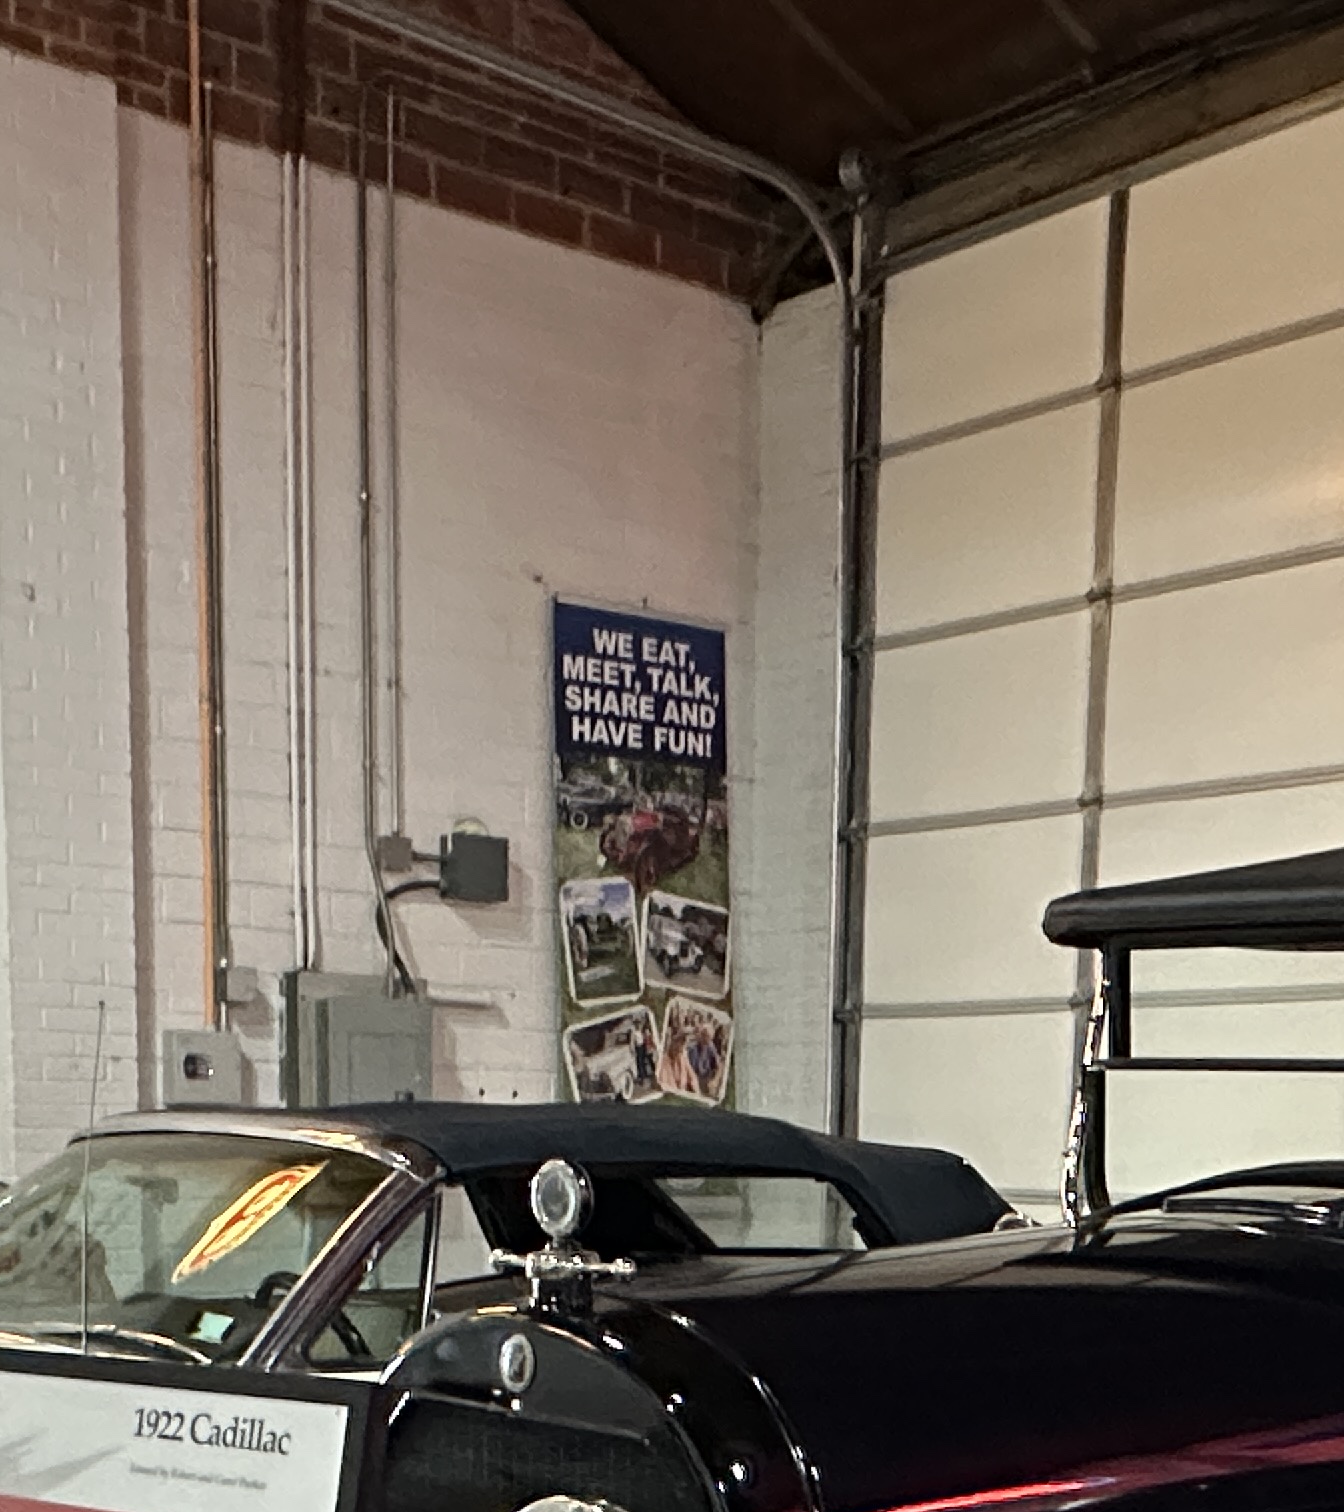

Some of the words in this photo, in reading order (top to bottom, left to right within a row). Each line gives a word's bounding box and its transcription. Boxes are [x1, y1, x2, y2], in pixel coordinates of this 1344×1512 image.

[593, 628, 633, 658] WE
[642, 636, 695, 675] EAT,
[562, 654, 641, 695] MEET,
[646, 666, 719, 707] TALK,
[565, 684, 655, 721] SHARE
[663, 699, 715, 729] AND
[571, 715, 643, 749] HAVE
[653, 726, 712, 758] FUN!
[134, 1408, 184, 1441] 1922
[190, 1413, 291, 1455] Cadillac
